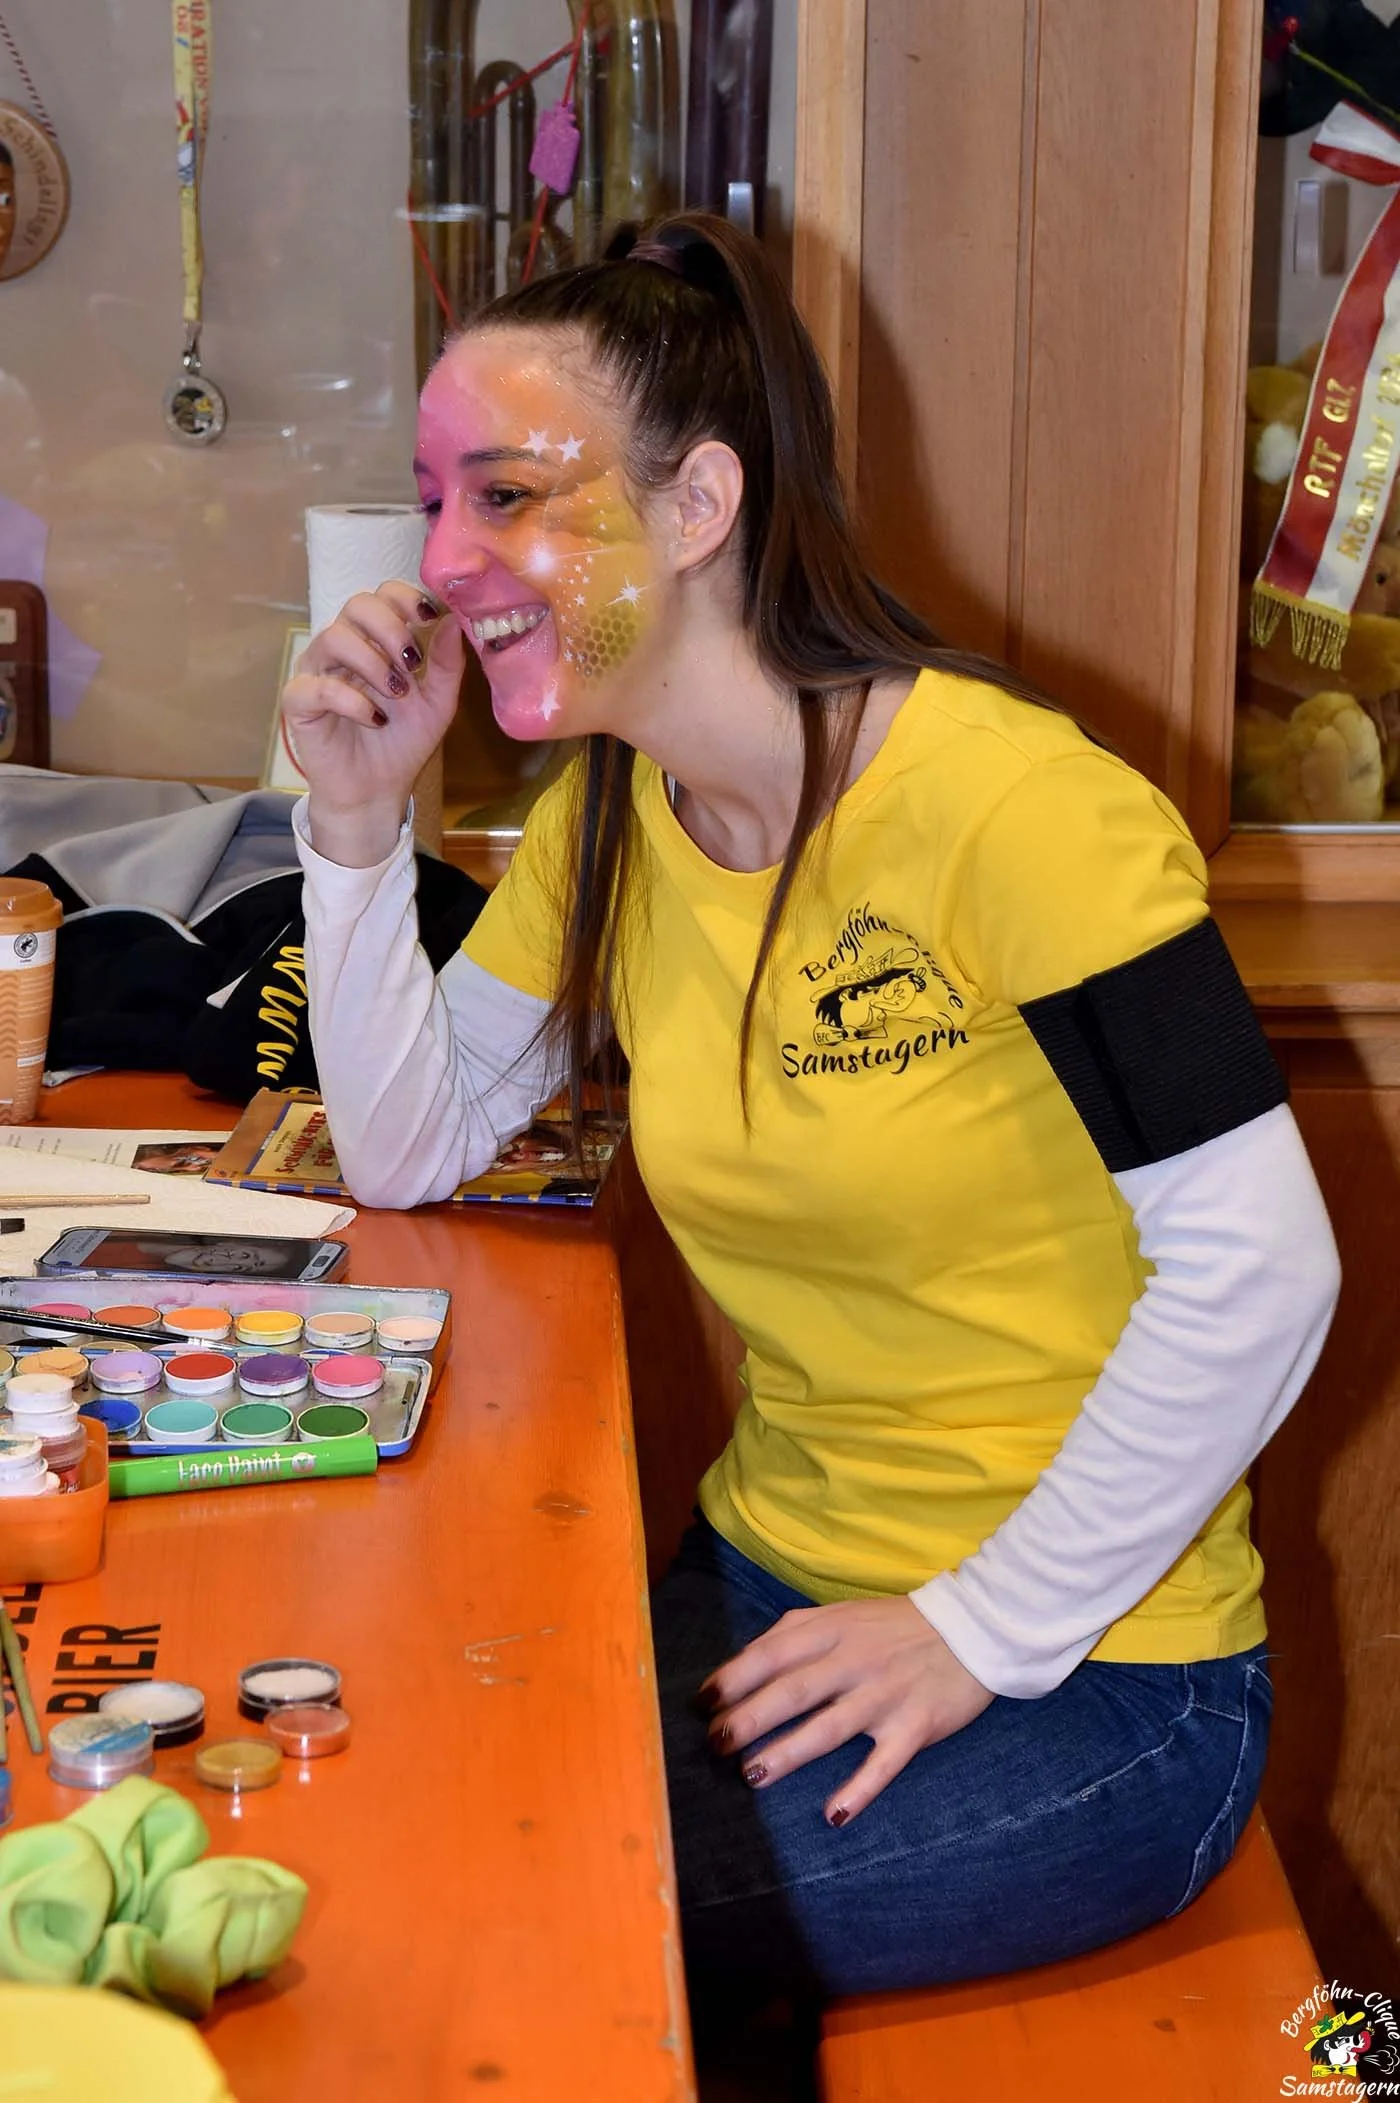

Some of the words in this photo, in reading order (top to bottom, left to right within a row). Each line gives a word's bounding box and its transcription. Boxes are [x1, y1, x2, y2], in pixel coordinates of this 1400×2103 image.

[1303, 435, 1344, 499] RTF
[781, 1028, 970, 1079] Samstagern
[178, 1459, 223, 1488] Face
[228, 1450, 282, 1484] Paint
